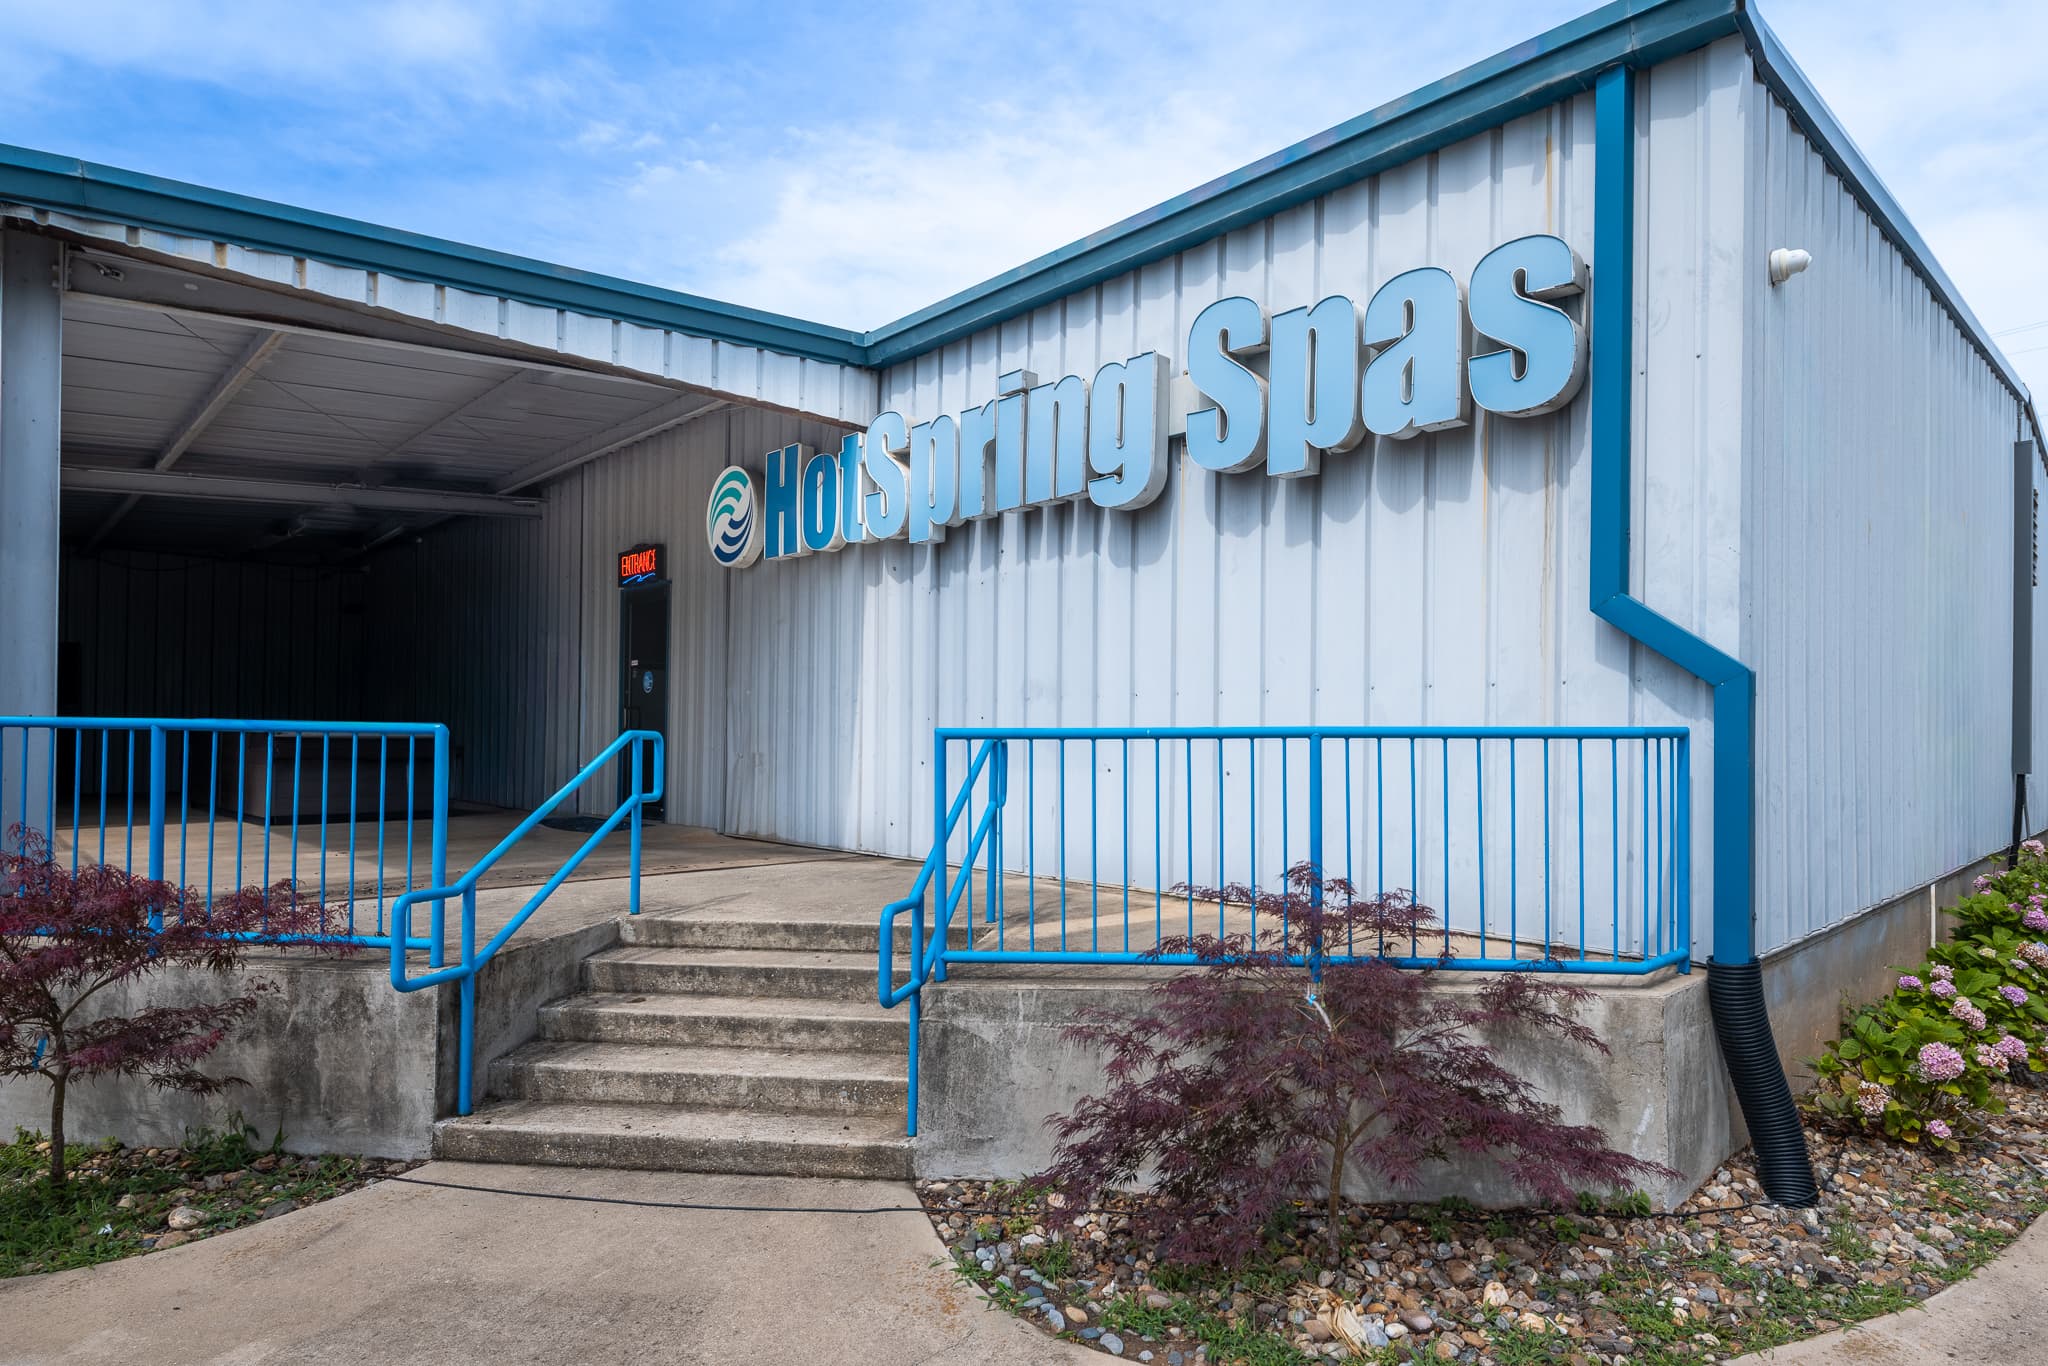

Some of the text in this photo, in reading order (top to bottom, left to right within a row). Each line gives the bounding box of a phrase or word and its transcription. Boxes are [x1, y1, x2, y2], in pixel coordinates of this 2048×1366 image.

[763, 234, 1585, 560] HotSpring Spas
[622, 550, 656, 576] ENTRANCE
